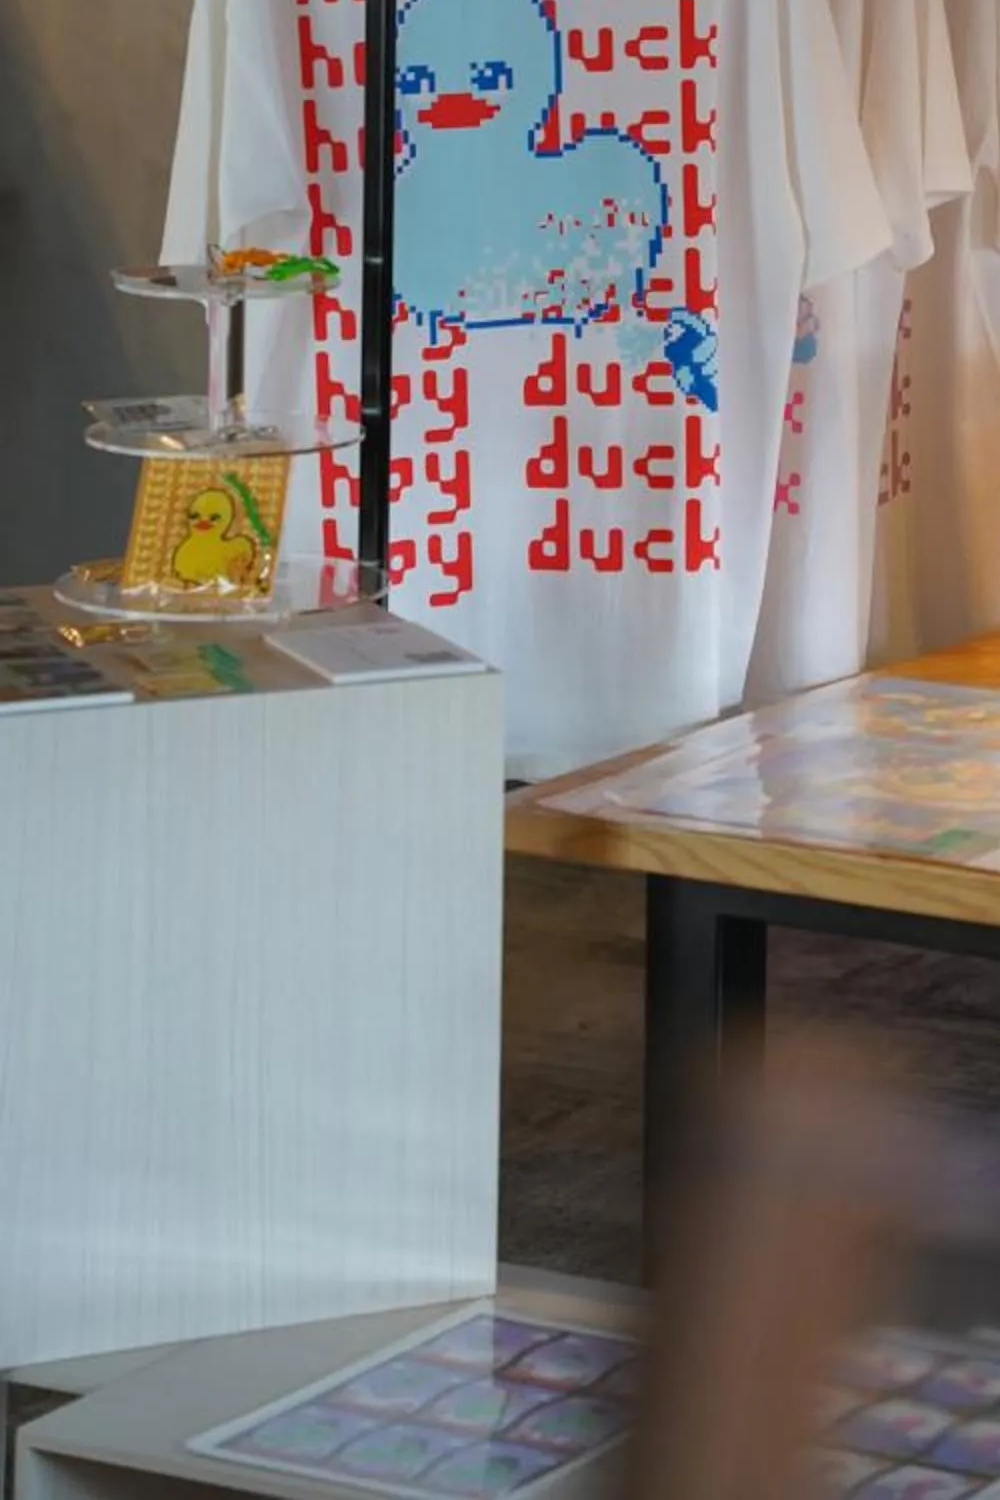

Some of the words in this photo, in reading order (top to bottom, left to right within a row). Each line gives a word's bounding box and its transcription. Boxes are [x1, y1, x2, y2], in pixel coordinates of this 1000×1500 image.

[523, 331, 675, 407] duc
[525, 414, 721, 489] duck
[527, 497, 721, 573] duck
